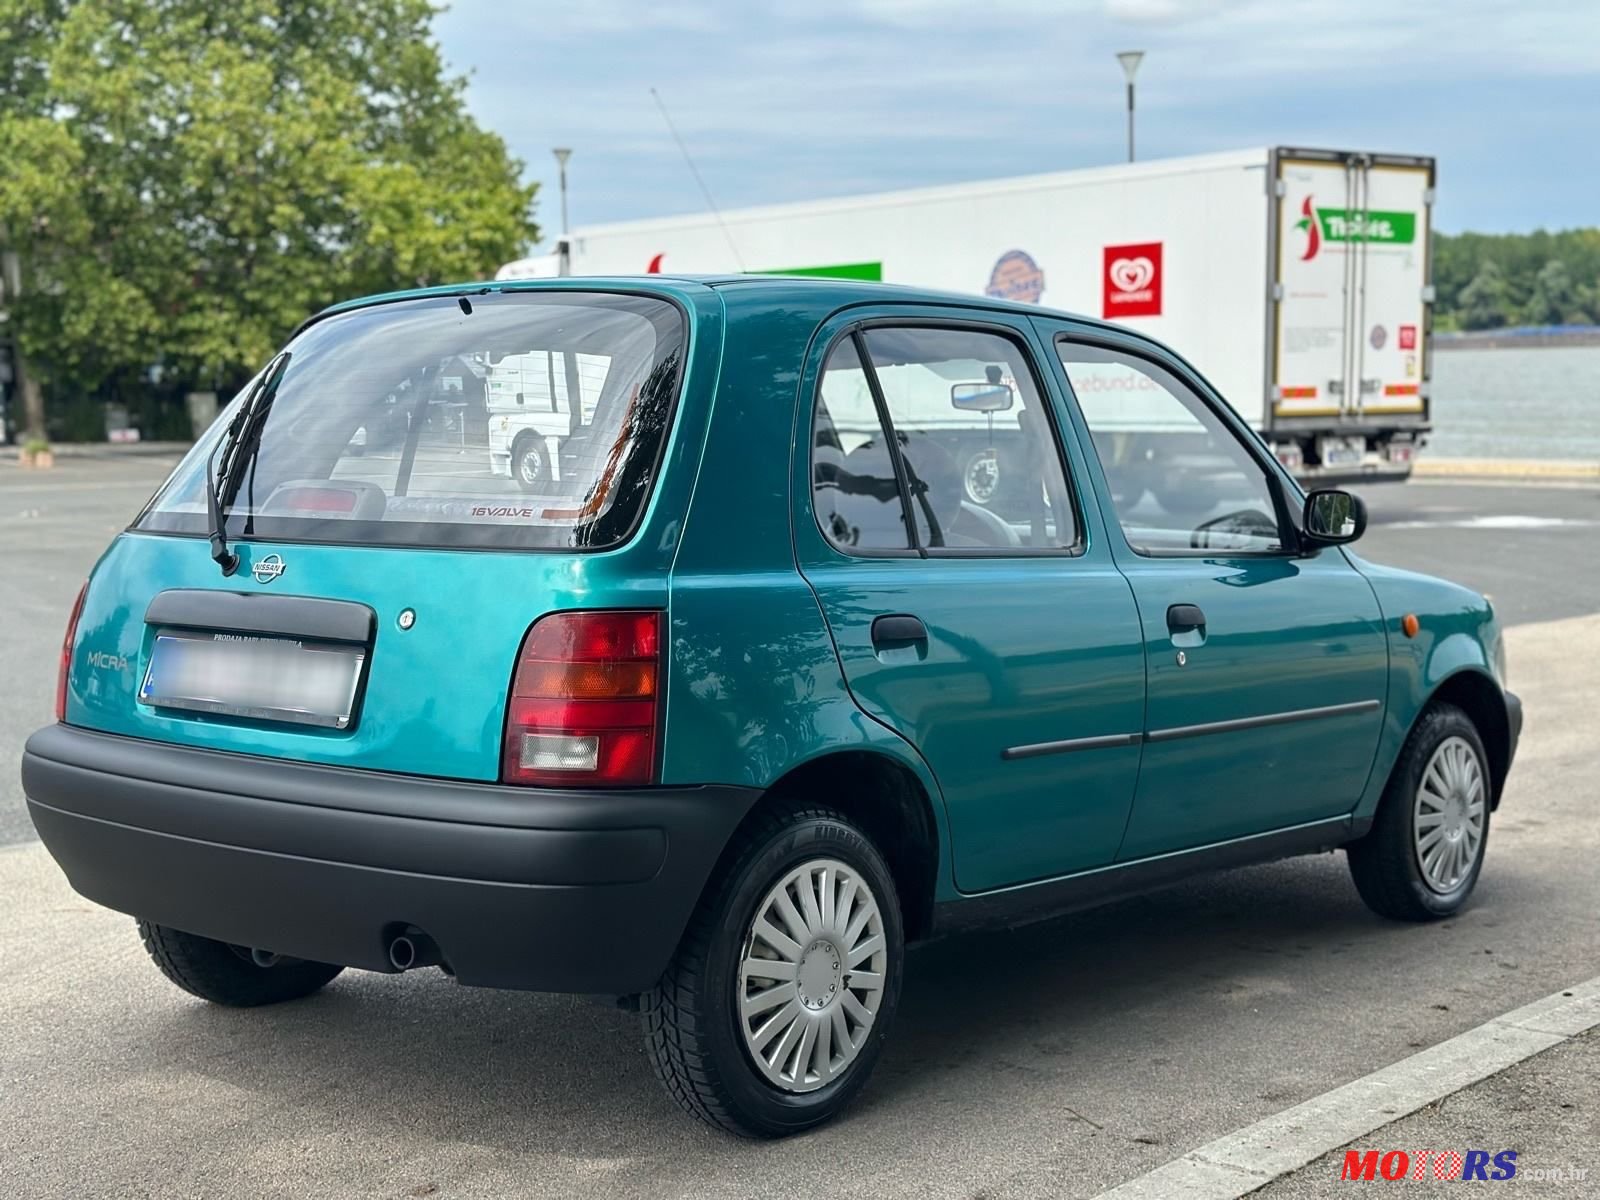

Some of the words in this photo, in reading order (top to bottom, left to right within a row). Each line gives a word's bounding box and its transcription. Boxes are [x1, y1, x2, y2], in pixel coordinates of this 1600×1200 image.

[471, 507, 533, 518] 16VALVE
[254, 563, 281, 572] NISSAN
[87, 650, 129, 672] MICRA
